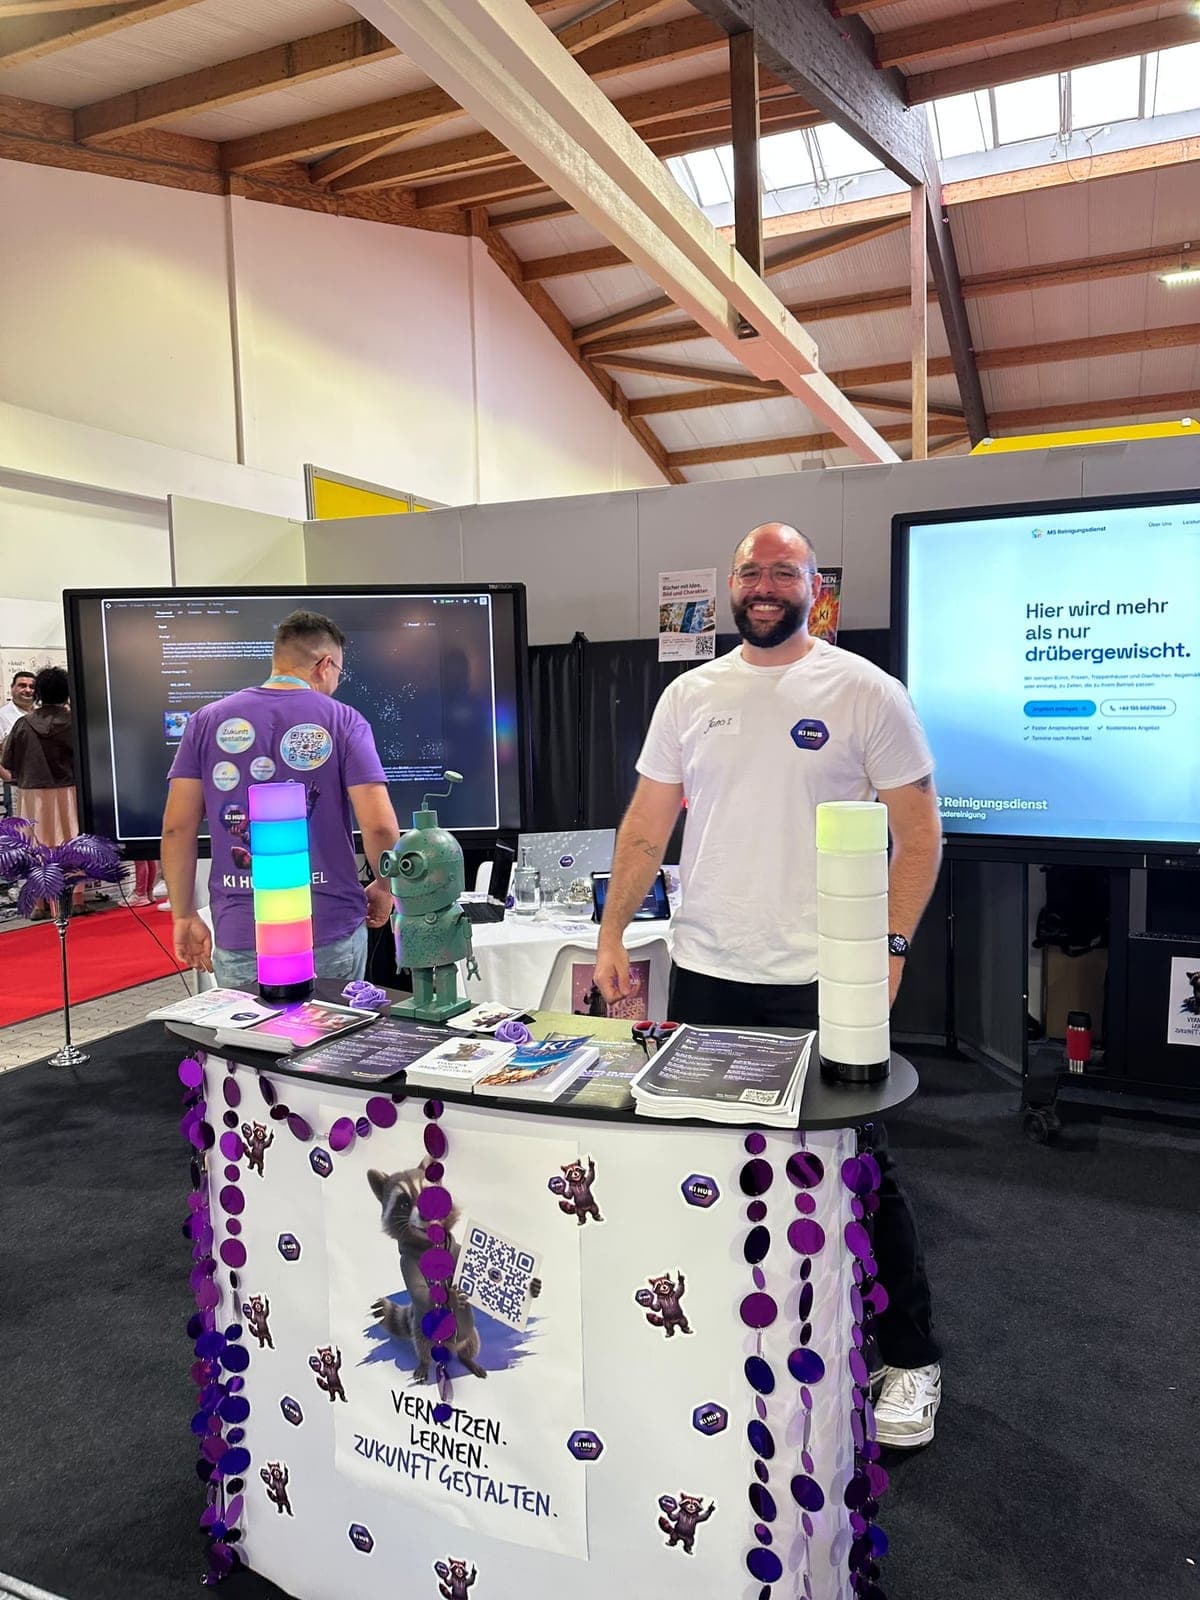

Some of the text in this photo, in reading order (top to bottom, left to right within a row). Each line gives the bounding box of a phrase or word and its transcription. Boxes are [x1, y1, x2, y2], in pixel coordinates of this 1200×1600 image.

[1057, 526, 1107, 536] Reinigungsdienst
[672, 589, 683, 597] und
[819, 610, 829, 620] KI
[1026, 598, 1169, 619] Hier wird mehr
[1026, 625, 1090, 641] als nur
[1025, 642, 1191, 664] drübergewischt.
[797, 729, 823, 738] KI HUB
[944, 796, 1048, 811] Reinigungsdienst
[223, 874, 236, 888] KI
[540, 1040, 572, 1051] KI
[697, 1187, 713, 1197] HUB
[391, 1389, 508, 1446] VERNTZEN.
[699, 1411, 721, 1426] KI HUB
[410, 1424, 489, 1469] LERNEN.
[582, 1441, 597, 1449] HUB
[353, 1434, 559, 1518] ZUKUNFT GESTALTEN.
